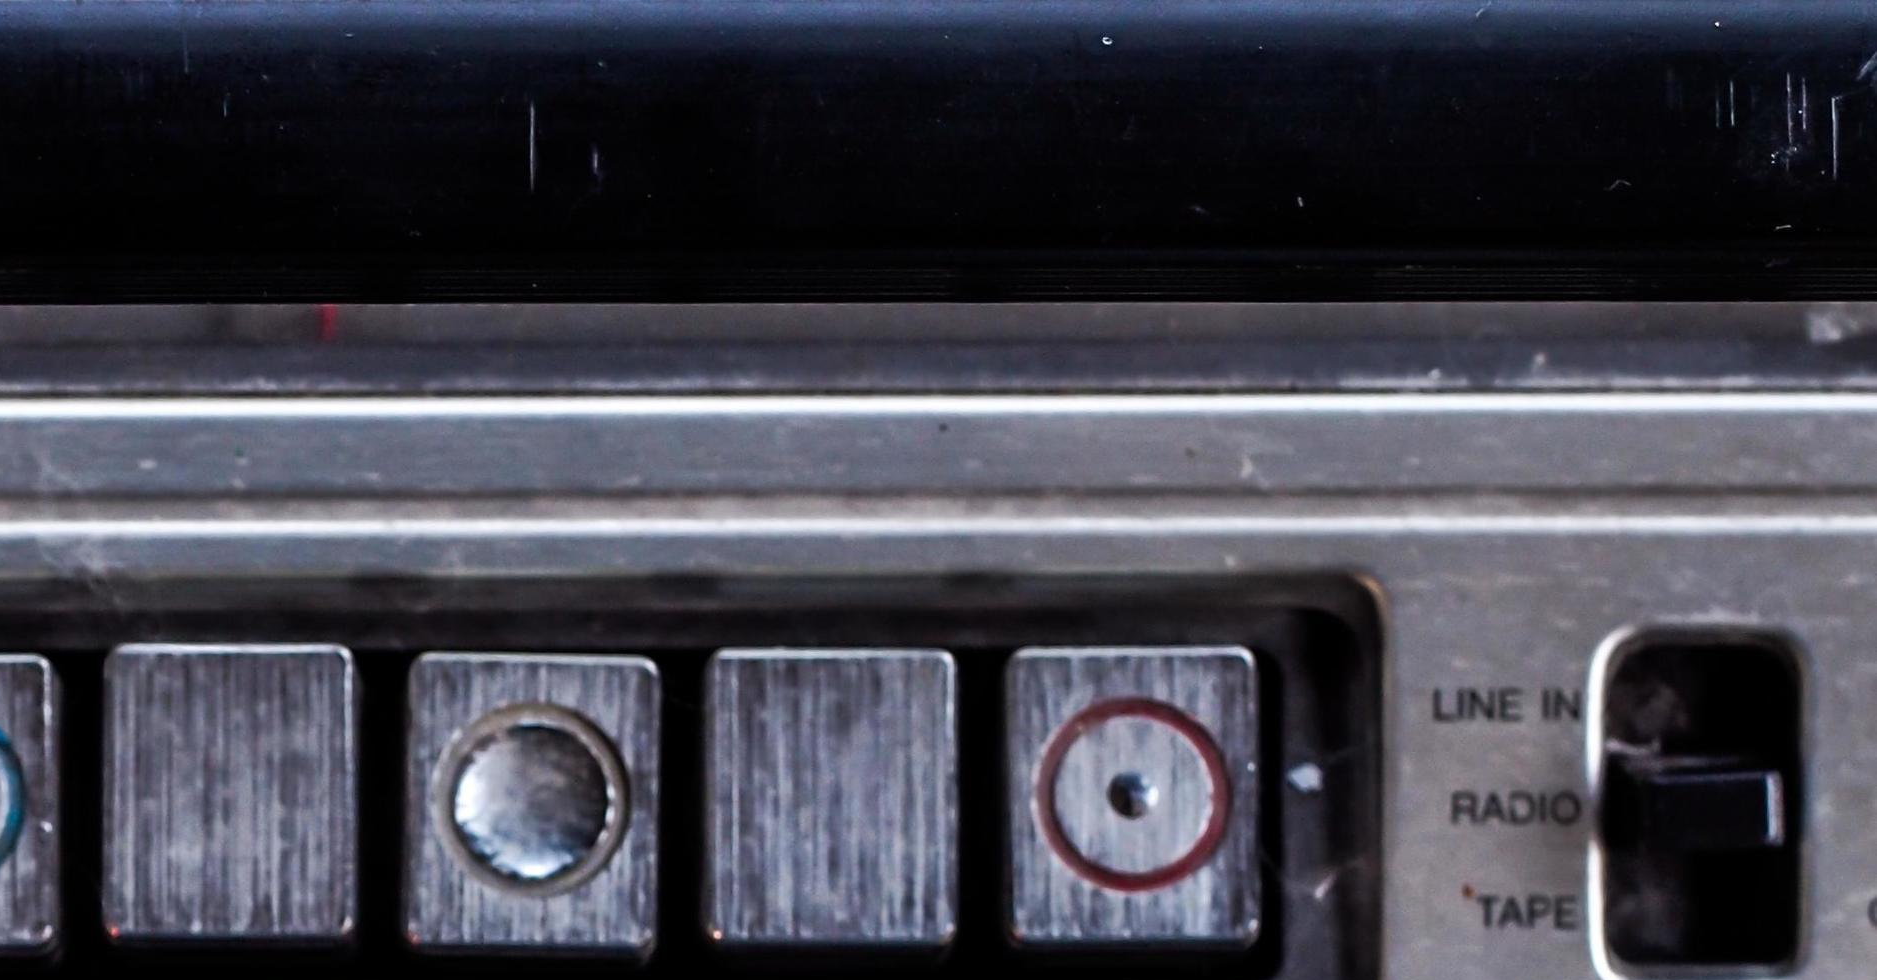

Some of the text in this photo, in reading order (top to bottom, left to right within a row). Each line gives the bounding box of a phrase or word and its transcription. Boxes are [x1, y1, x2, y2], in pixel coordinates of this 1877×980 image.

[1432, 688, 1582, 722] LINE IN
[1450, 791, 1582, 826] RADIO
[1476, 895, 1579, 929] TAPE
